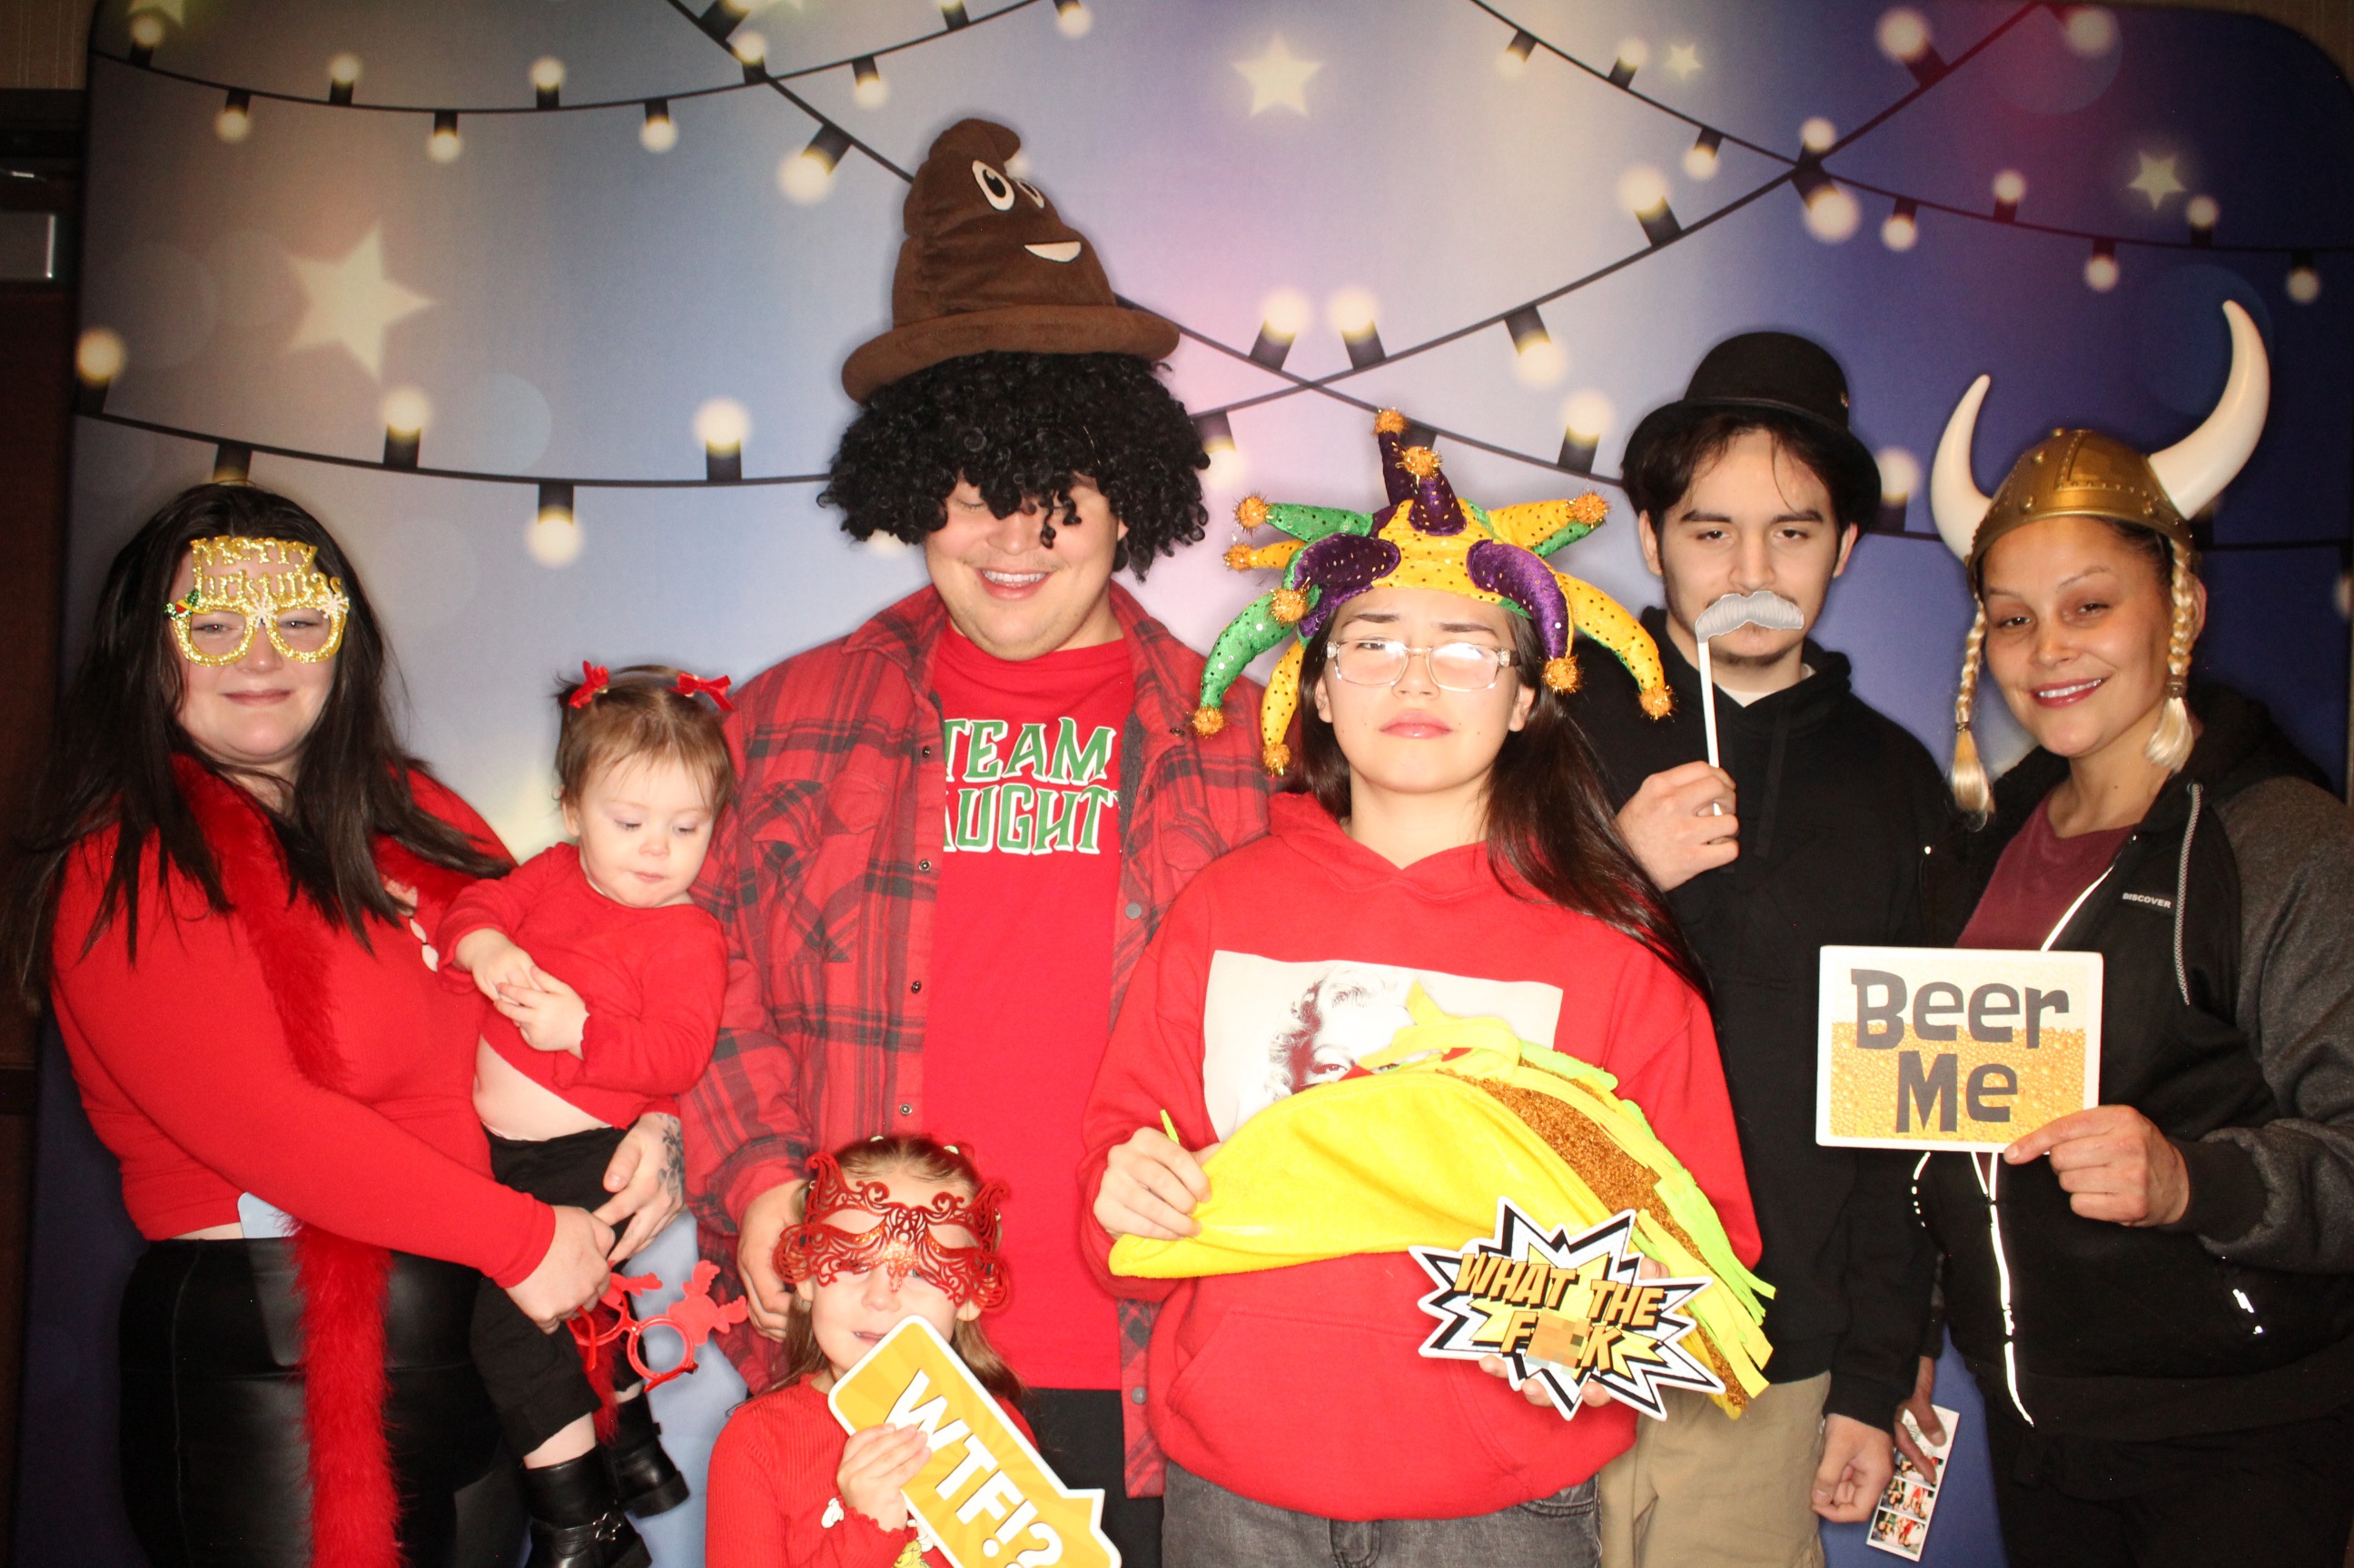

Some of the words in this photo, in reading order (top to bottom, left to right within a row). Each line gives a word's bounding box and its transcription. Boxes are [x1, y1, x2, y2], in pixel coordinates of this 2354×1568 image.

[944, 716, 1116, 786] TEAM
[2122, 892, 2171, 908] DISCOVER
[1851, 968, 2070, 1050] Beer
[1895, 1050, 2018, 1133] Me
[1453, 1252, 1578, 1311] WHAT
[1587, 1279, 1668, 1329] THE
[1500, 1310, 1625, 1376] FK
